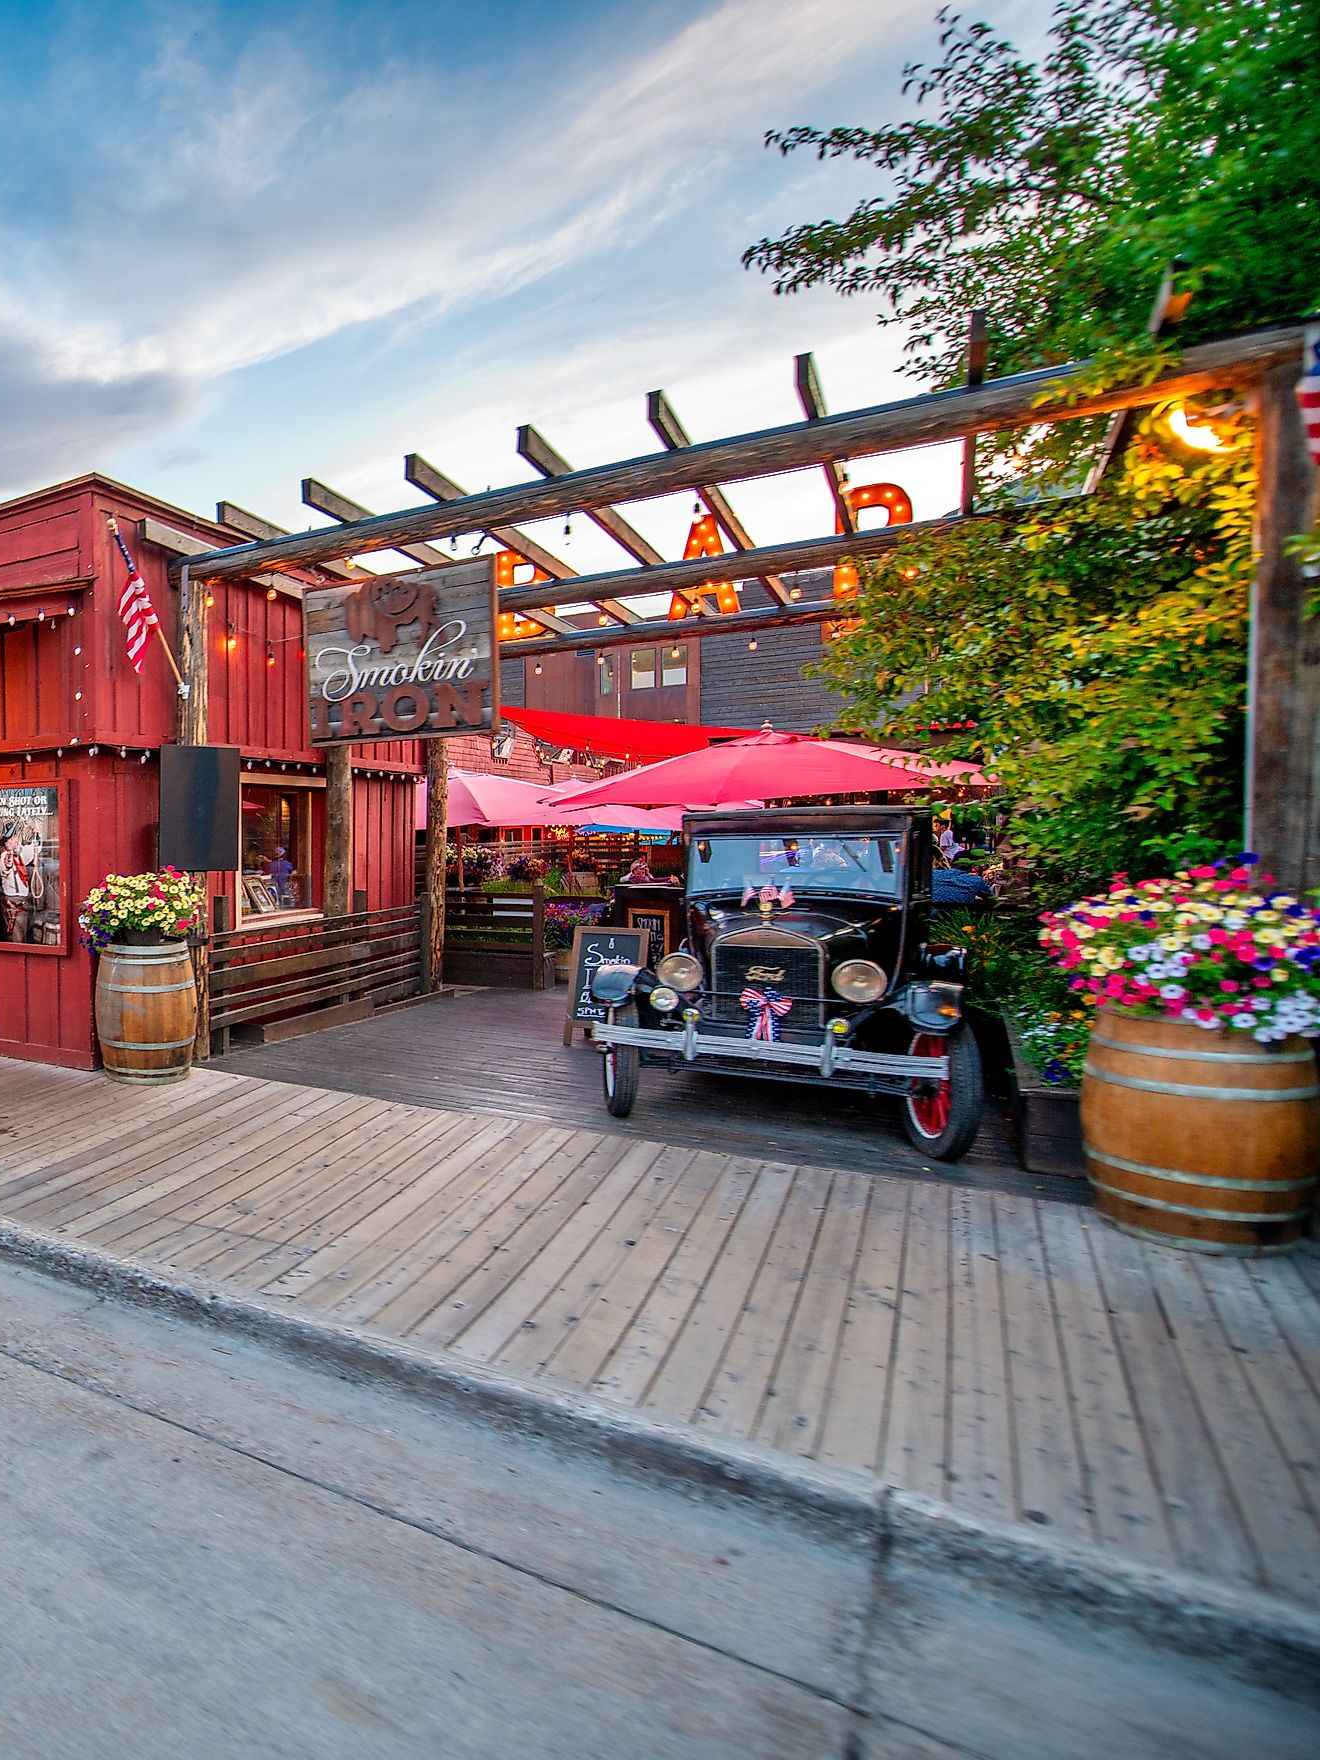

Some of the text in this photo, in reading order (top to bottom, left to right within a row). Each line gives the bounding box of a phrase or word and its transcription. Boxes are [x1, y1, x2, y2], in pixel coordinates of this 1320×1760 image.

[310, 679, 488, 738] IRON
[8, 795, 33, 808] SHOT
[33, 795, 48, 806] OR
[744, 965, 786, 981] Ford
